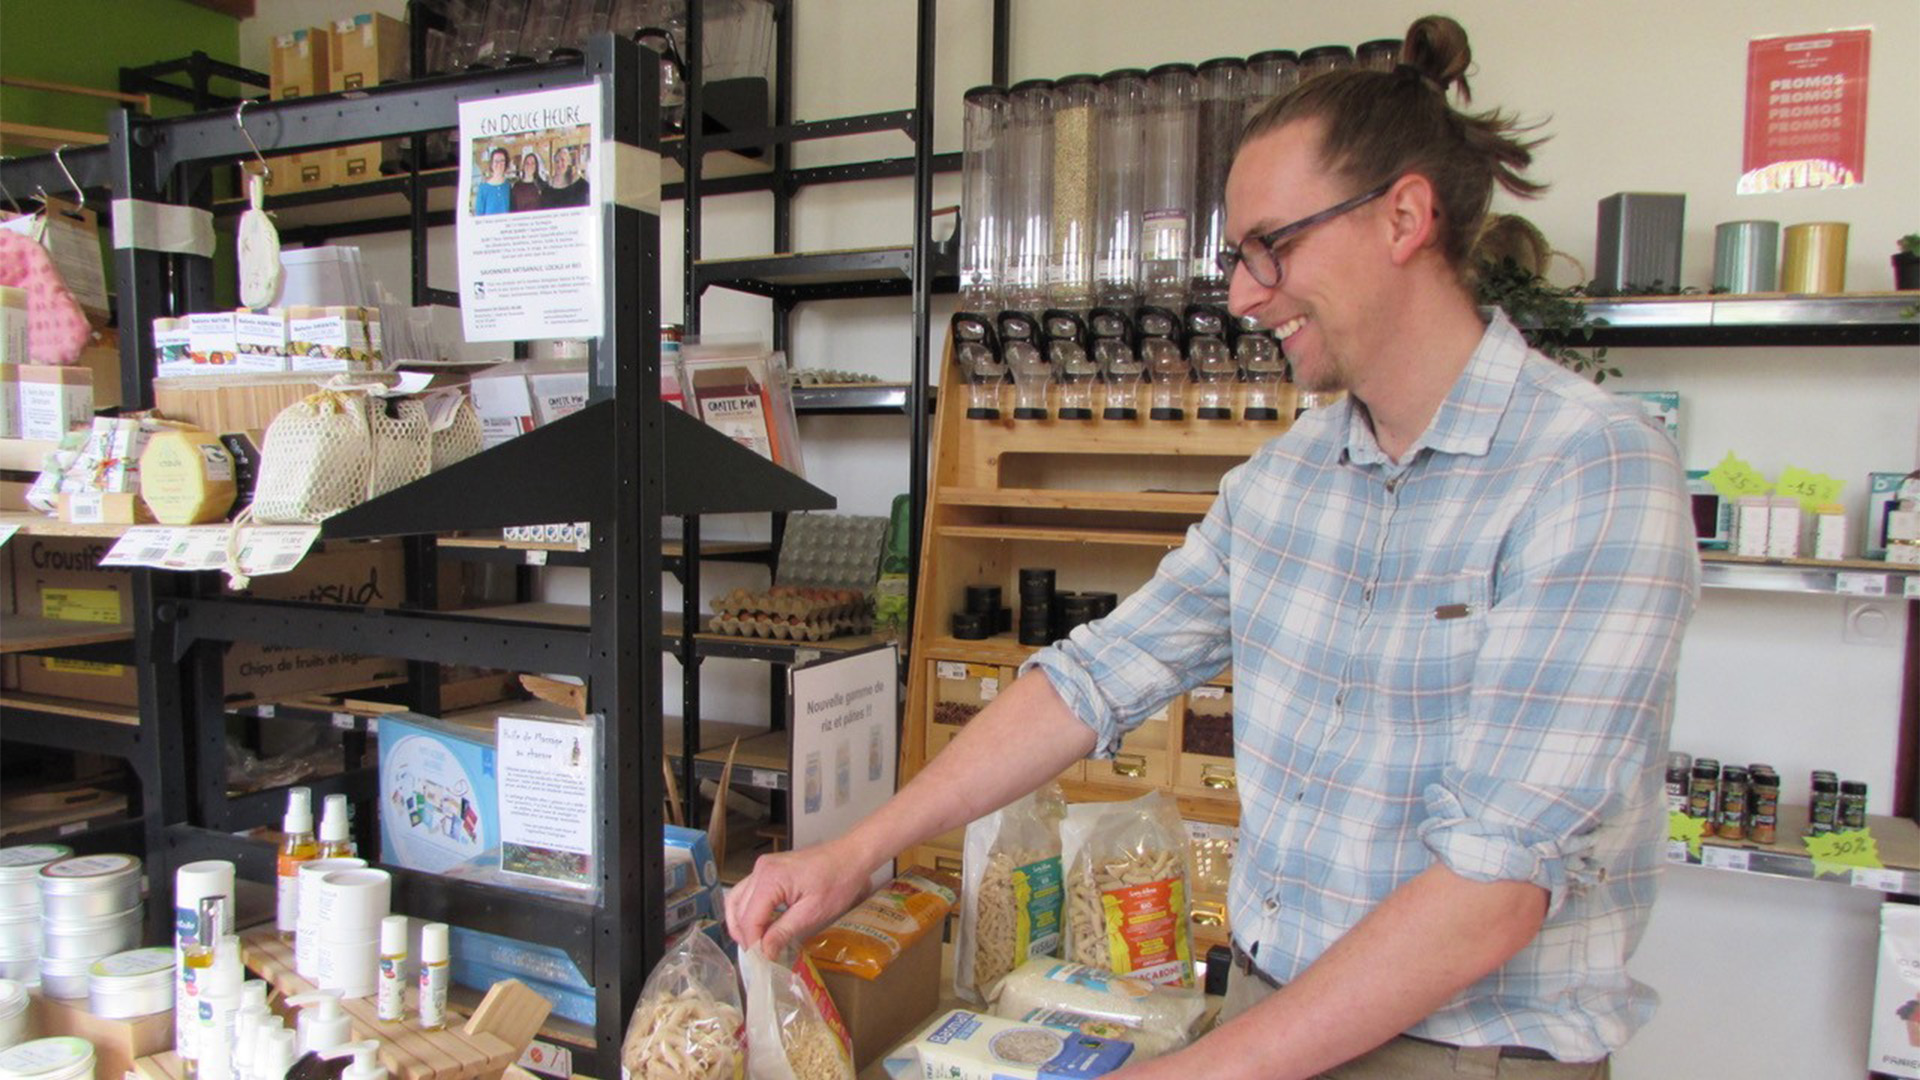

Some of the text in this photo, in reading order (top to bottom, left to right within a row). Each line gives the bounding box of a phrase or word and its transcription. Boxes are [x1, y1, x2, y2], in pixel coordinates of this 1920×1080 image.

[1770, 73, 1845, 91] PROMOS
[1769, 88, 1844, 105] PROMOS
[481, 105, 581, 135] EN DOUCE HEURE
[1768, 103, 1843, 119] PROMOS
[1768, 117, 1842, 133] PROMOS
[239, 661, 273, 678] Chips
[277, 659, 292, 672] de
[296, 655, 325, 669] fruits
[327, 654, 339, 665] et
[807, 680, 884, 715] Nouvelle gamme de
[821, 718, 833, 733] riz
[834, 715, 842, 728] et
[1882, 1055, 1920, 1070] PANIE
